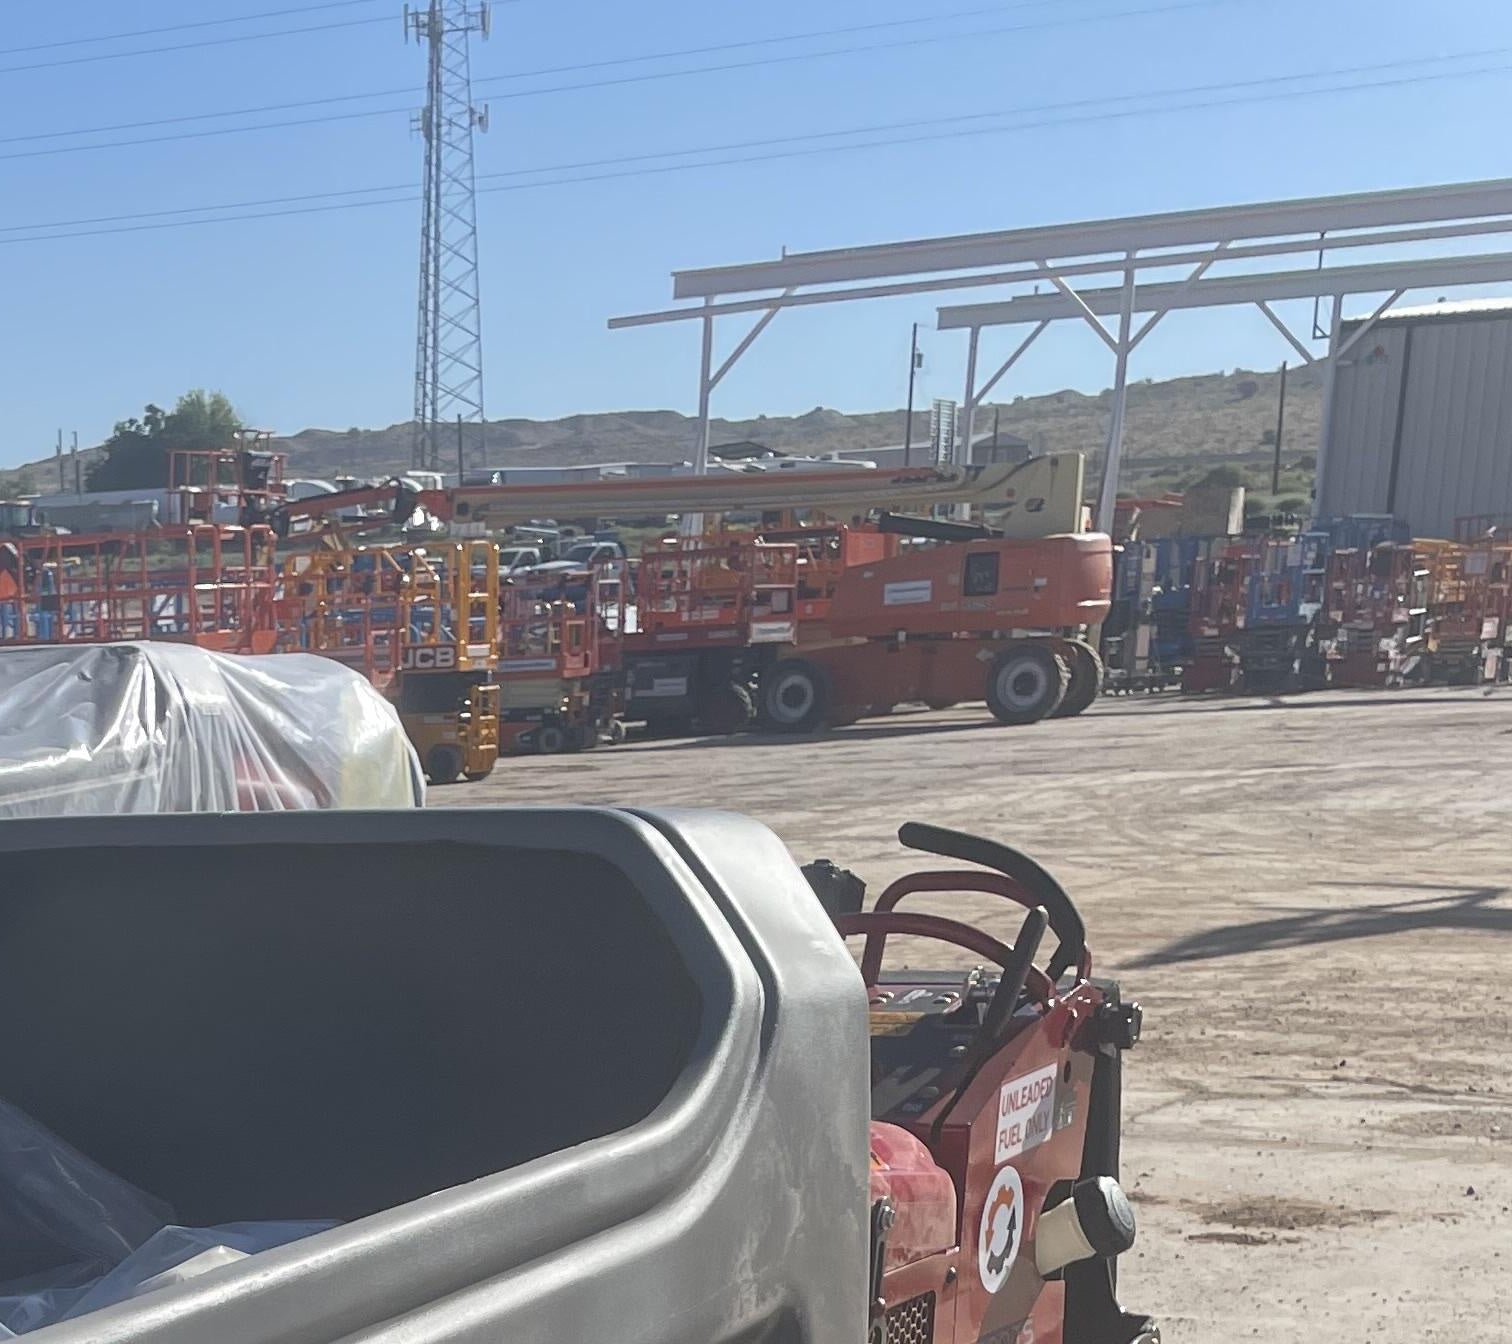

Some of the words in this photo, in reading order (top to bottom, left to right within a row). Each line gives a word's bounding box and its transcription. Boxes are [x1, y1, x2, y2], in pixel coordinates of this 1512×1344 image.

[402, 647, 455, 669] JCB
[1001, 1076, 1053, 1117] UNLEADED
[998, 1122, 1022, 1152] FUEL
[1026, 1111, 1050, 1139] ONLY
